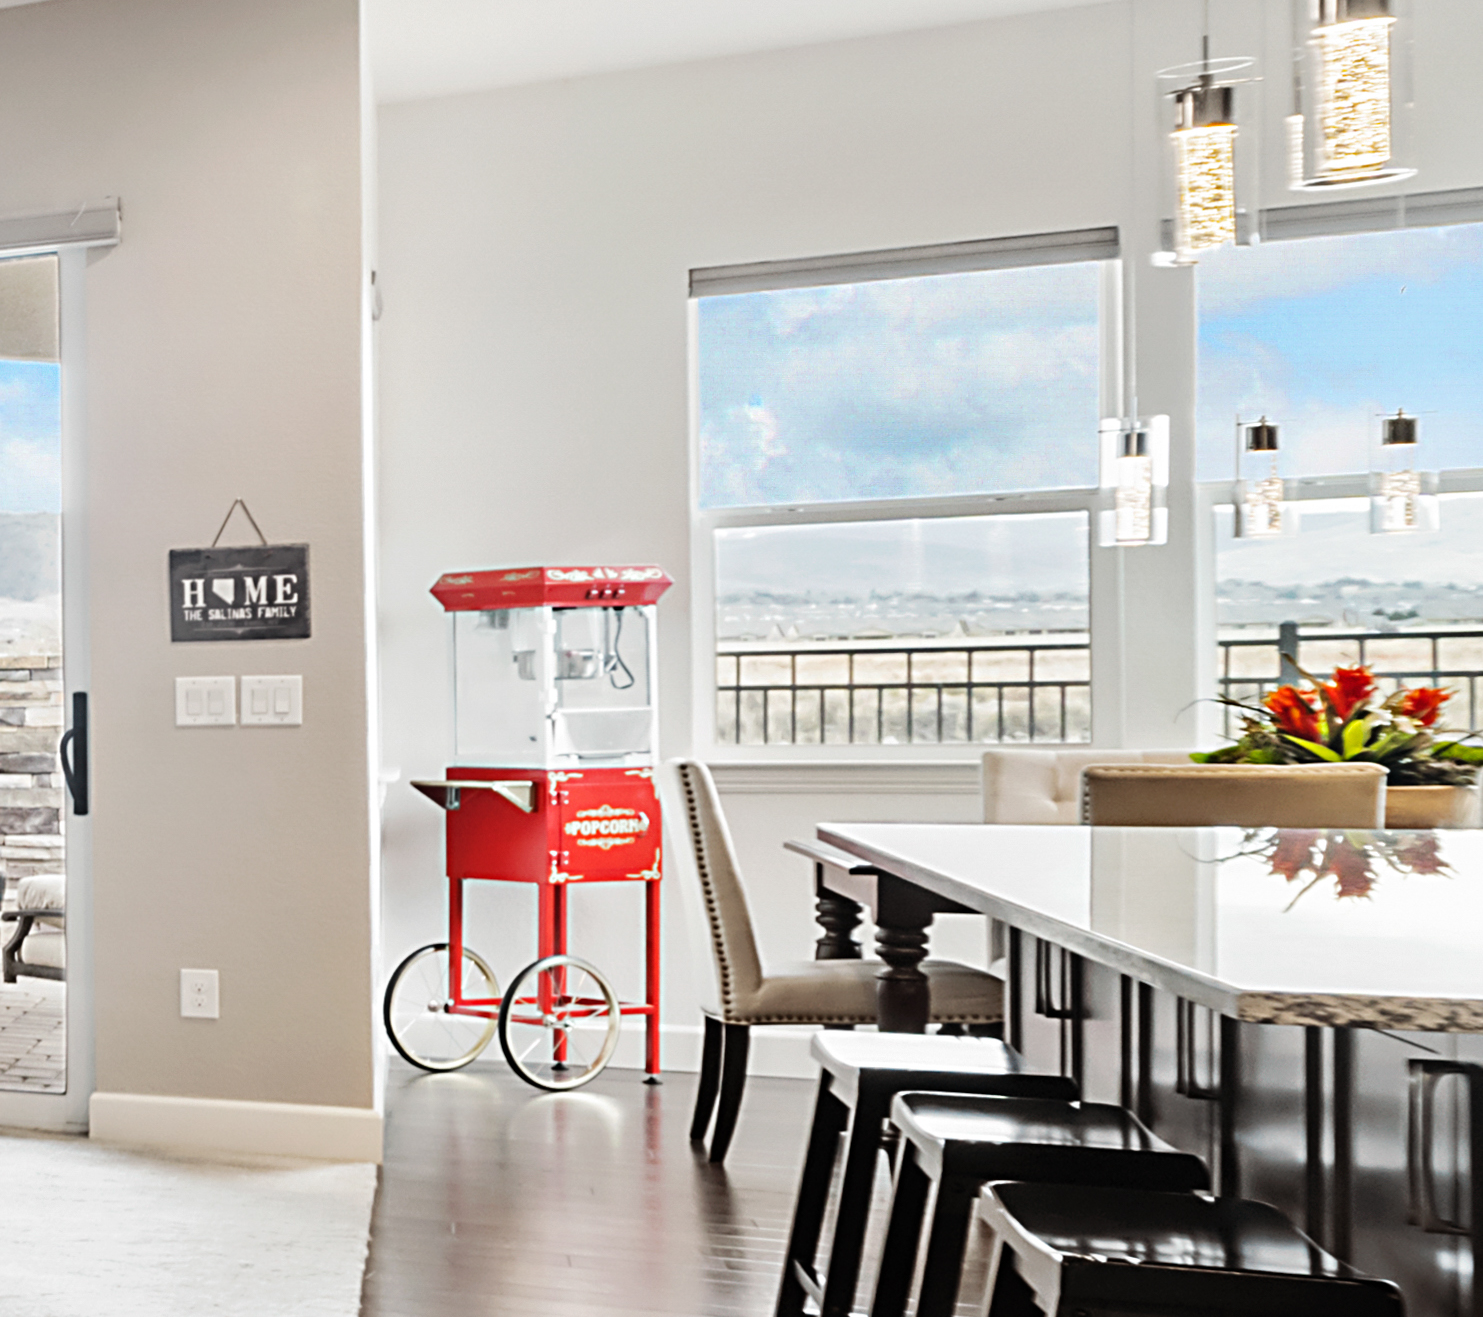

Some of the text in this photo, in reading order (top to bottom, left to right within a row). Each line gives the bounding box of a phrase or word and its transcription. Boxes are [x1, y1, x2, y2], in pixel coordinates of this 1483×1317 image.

[181, 574, 298, 608] HME
[183, 606, 297, 621] THE SALINAS FAMILY
[571, 818, 639, 836] POPCORN
